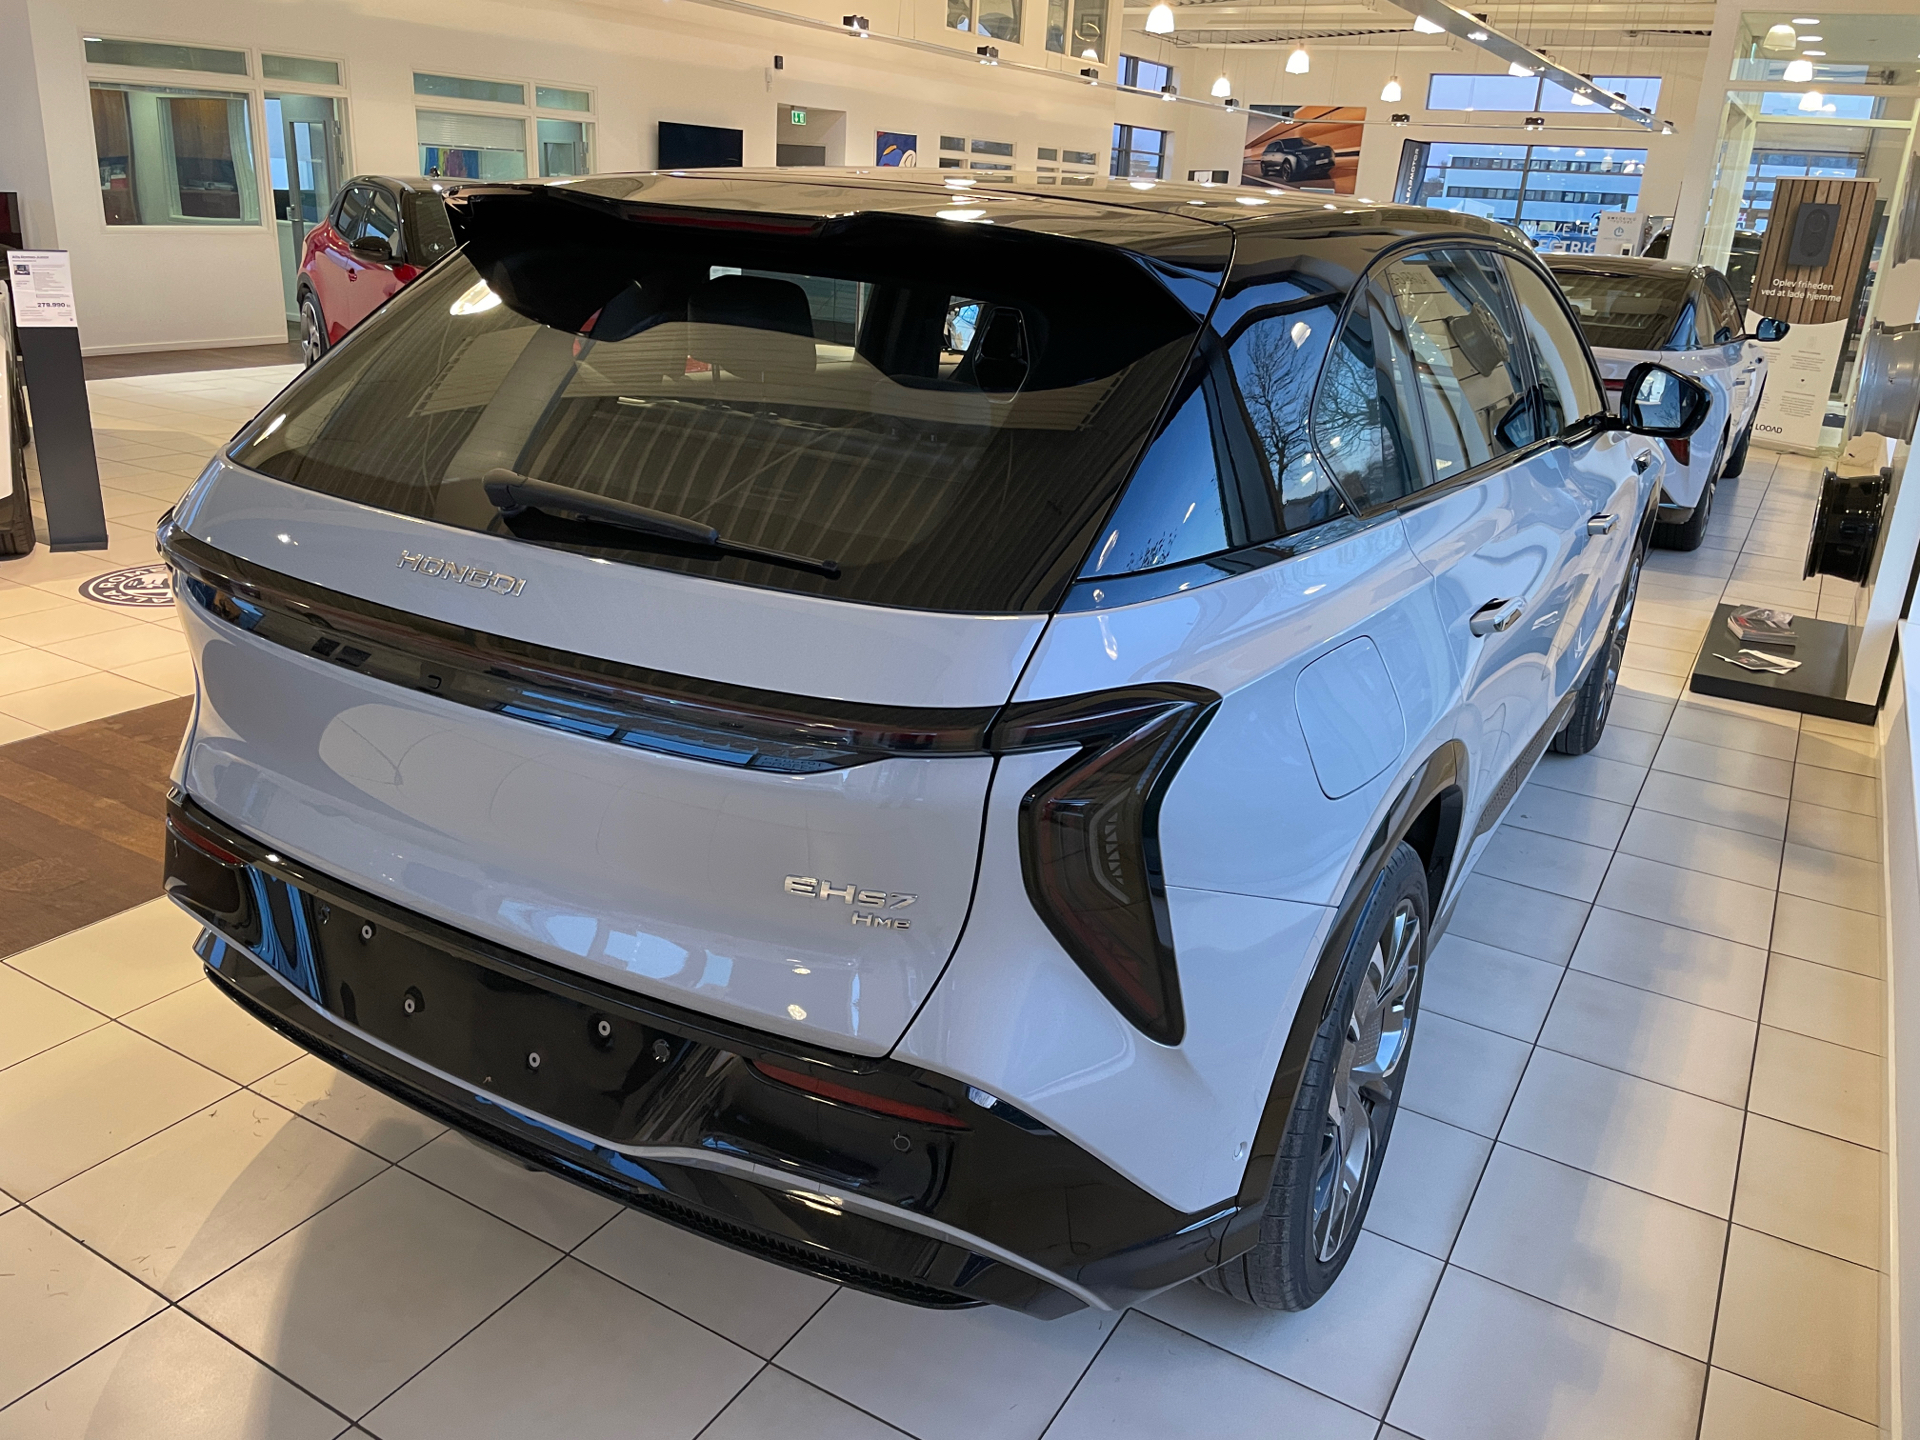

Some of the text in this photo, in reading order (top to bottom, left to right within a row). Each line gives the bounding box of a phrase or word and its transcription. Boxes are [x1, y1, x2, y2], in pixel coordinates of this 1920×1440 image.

[1522, 222, 1573, 237] MOVE
[1772, 278, 1834, 291] Oplev friheden
[1787, 290, 1805, 299] lade
[1806, 292, 1842, 303] hjemme
[396, 549, 527, 597] HONGQI
[784, 874, 919, 910] EHS7
